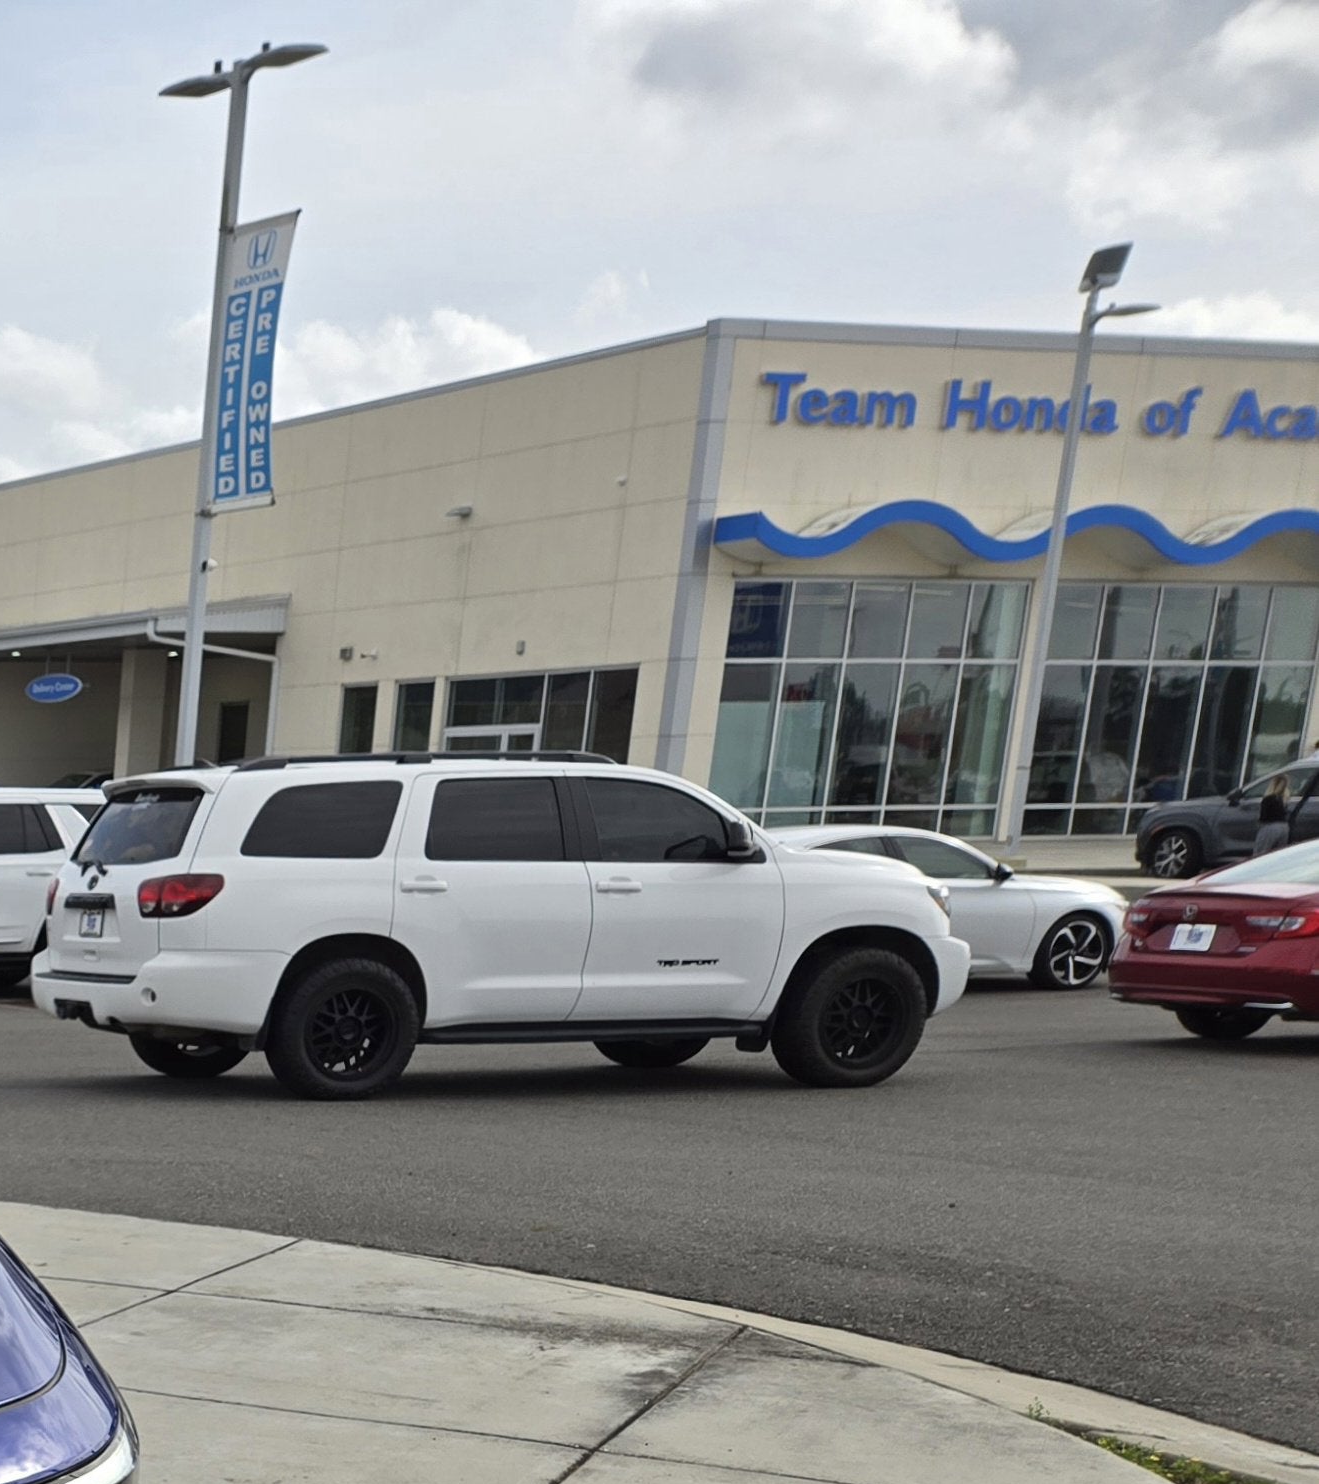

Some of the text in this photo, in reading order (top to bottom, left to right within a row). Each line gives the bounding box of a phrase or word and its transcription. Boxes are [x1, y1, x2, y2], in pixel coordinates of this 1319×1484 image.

[234, 269, 281, 289] HONDA
[217, 297, 246, 496] CERTIFIED
[248, 288, 276, 489] PRE OWNED
[763, 372, 1319, 439] Team Honda of Aca
